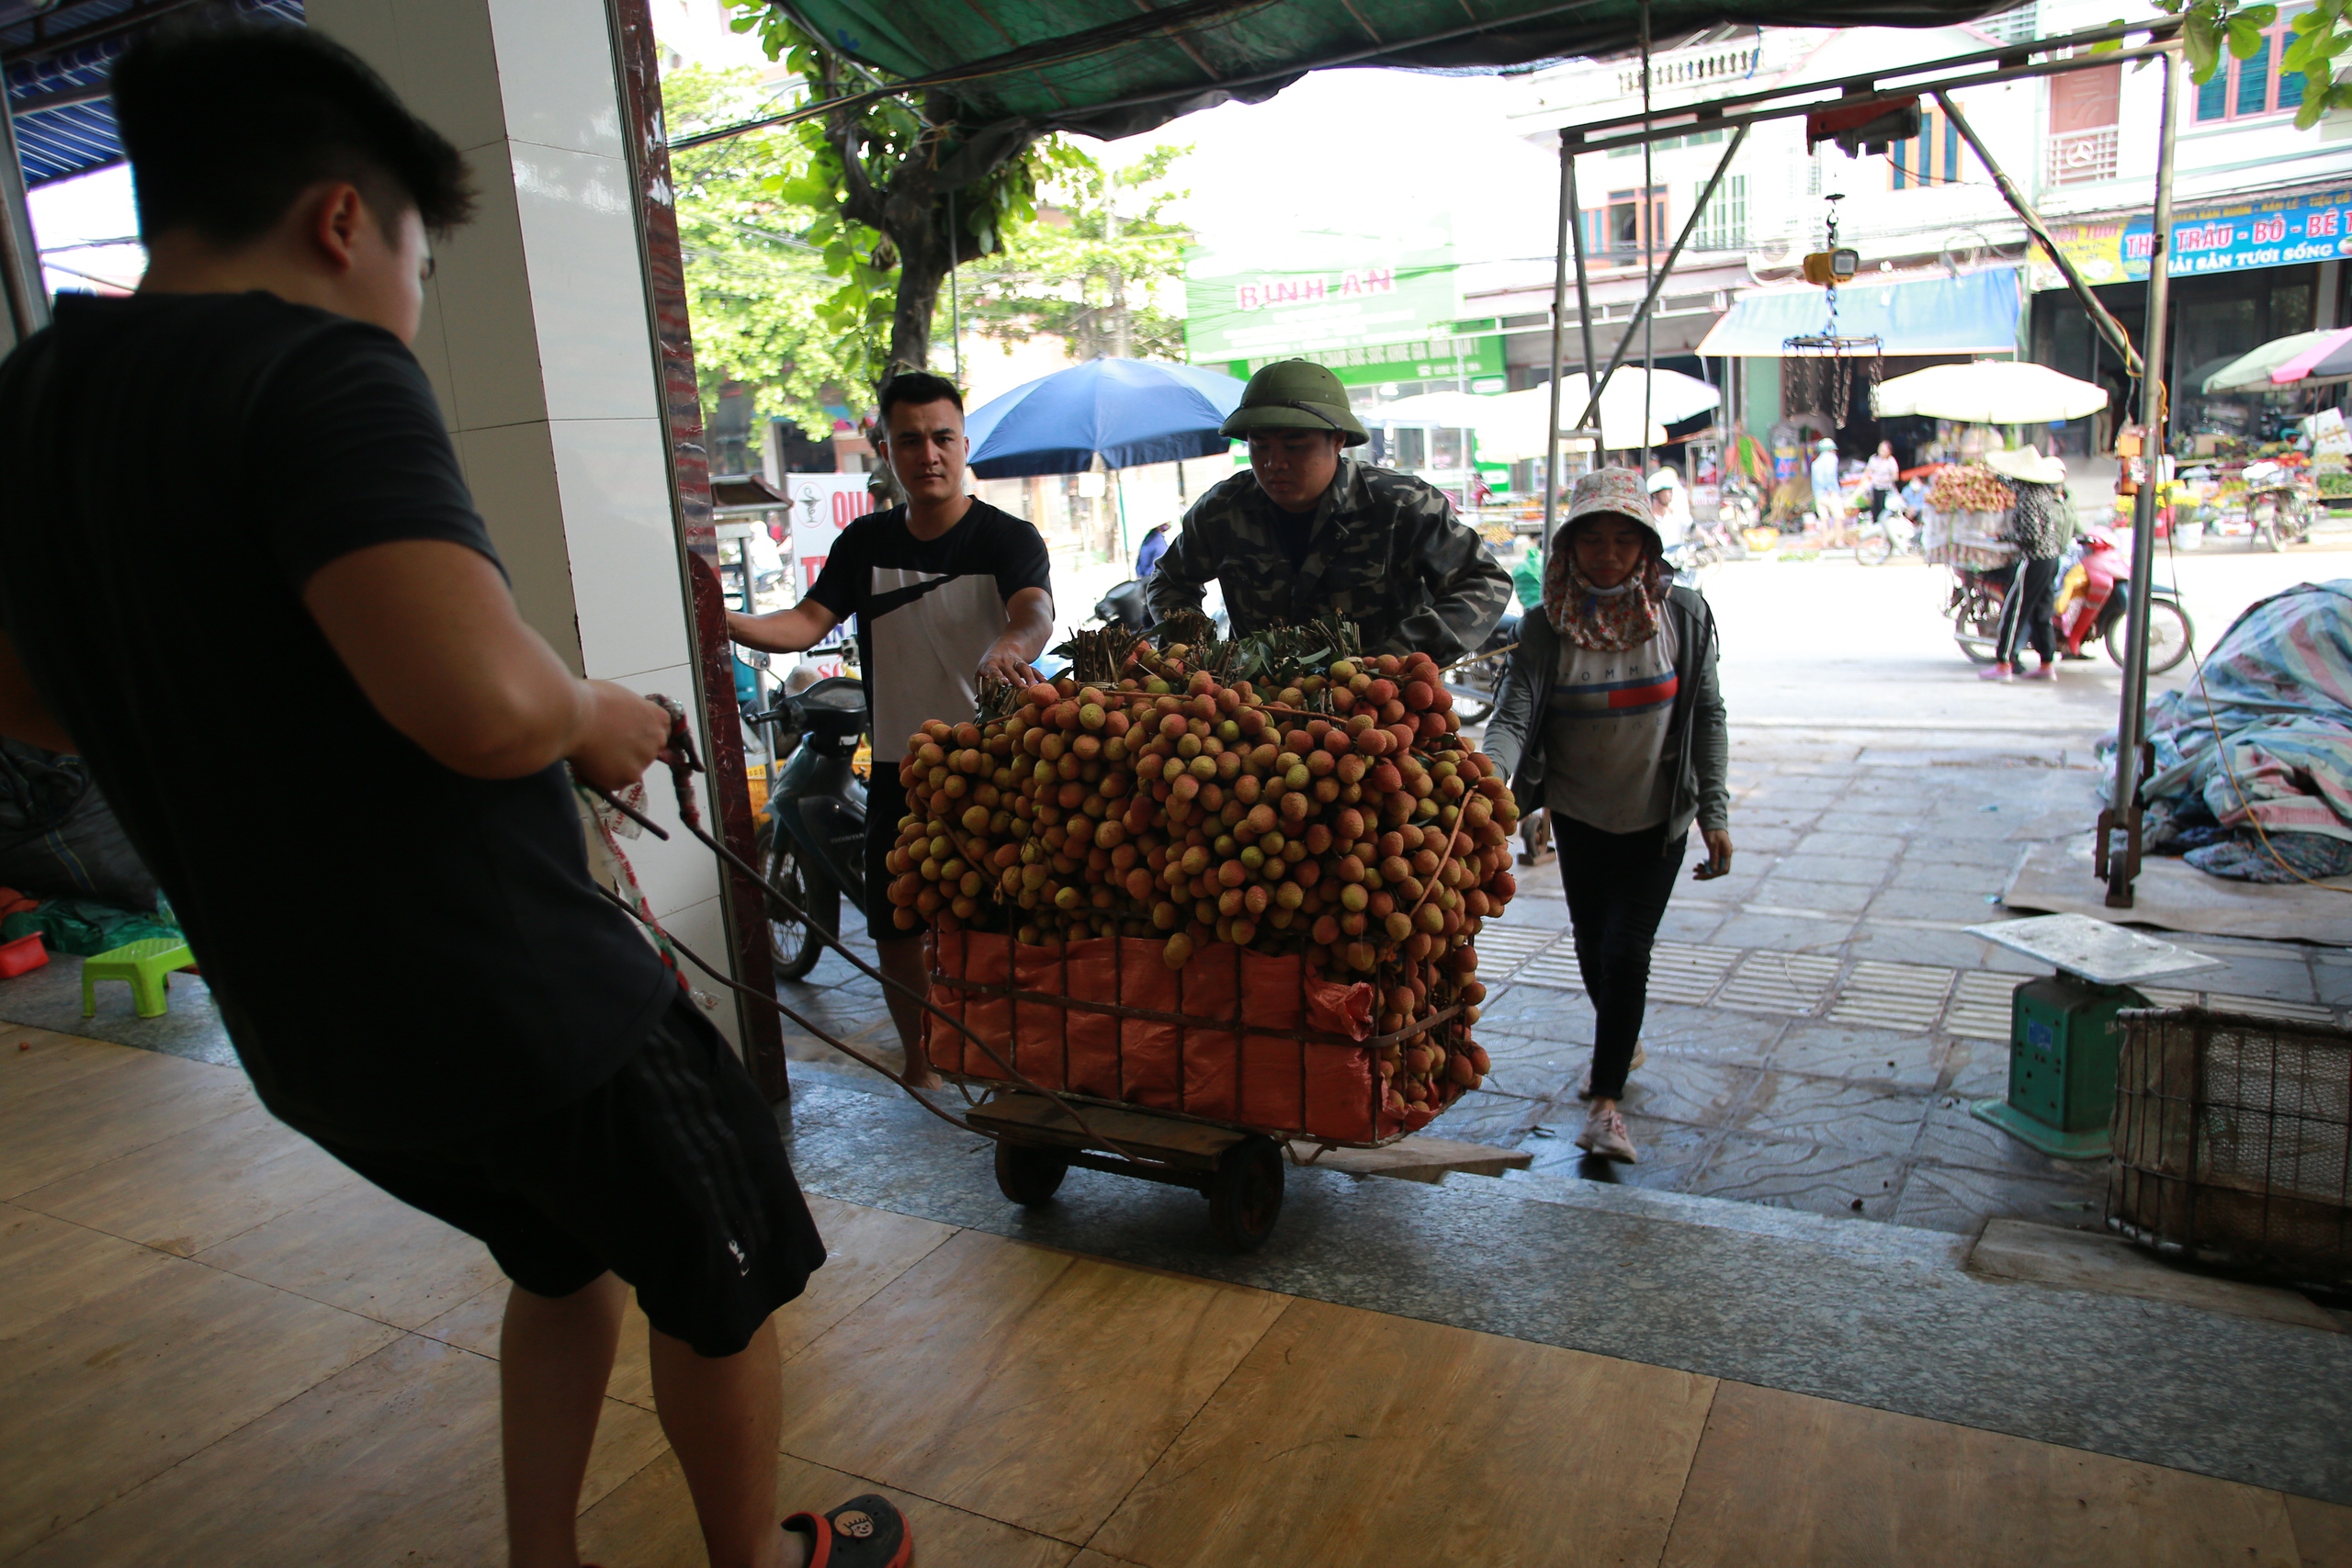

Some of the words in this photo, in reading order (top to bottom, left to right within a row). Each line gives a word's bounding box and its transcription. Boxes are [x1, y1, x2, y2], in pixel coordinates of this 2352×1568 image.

[2177, 222, 2233, 252] TRÂU
[2196, 250, 2233, 271] SẢN
[2235, 247, 2279, 266] TƯƠI
[2282, 241, 2334, 261] SỐNG
[1341, 268, 1392, 296] AN
